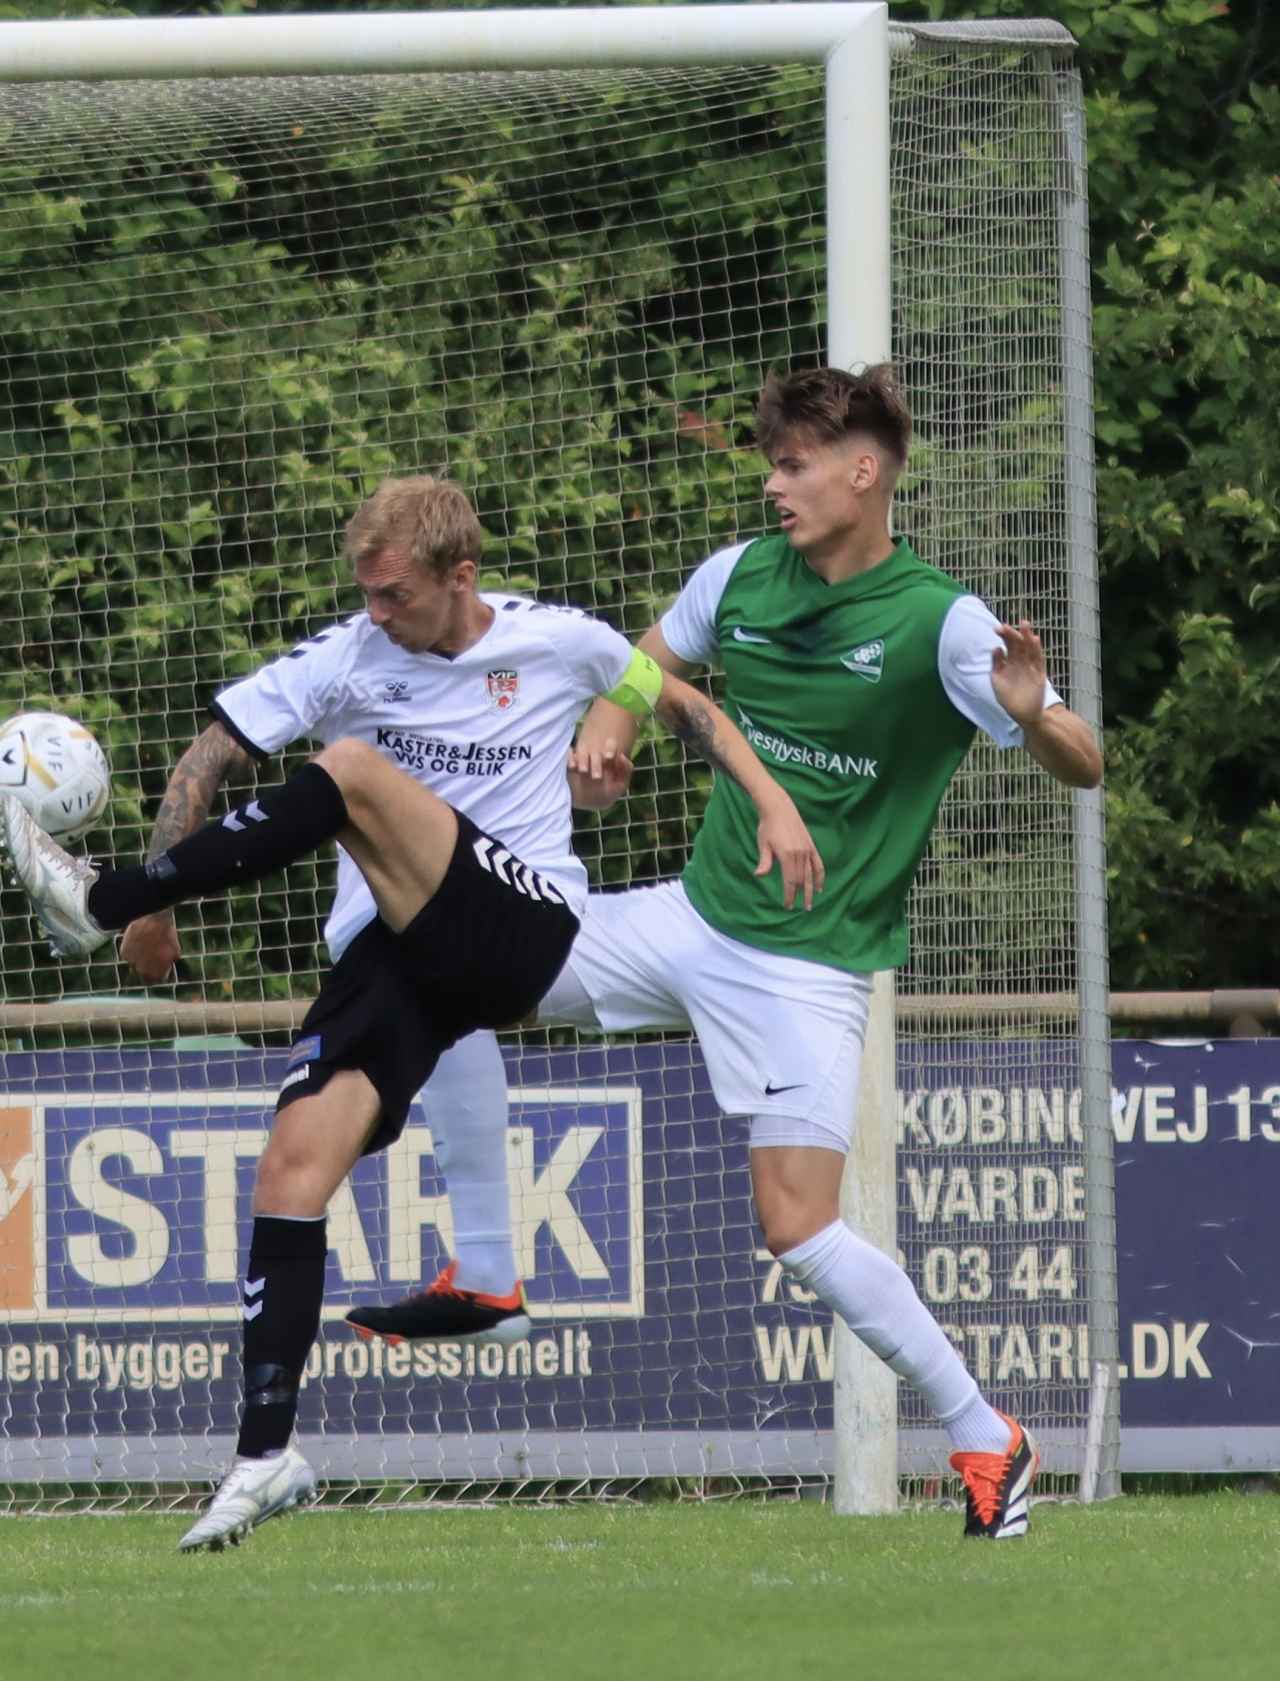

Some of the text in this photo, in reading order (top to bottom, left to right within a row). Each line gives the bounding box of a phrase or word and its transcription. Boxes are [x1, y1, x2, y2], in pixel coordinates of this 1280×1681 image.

[376, 727, 532, 762] KASTER&JESSEN
[393, 750, 506, 777] VVS OG BLIK
[747, 726, 878, 778] vestjyskBANK
[60, 791, 95, 814] VIF
[906, 1166, 1086, 1221] VARDE
[924, 1247, 993, 1302] 03
[1009, 1245, 1078, 1301] 44
[77, 1334, 229, 1391] bygger
